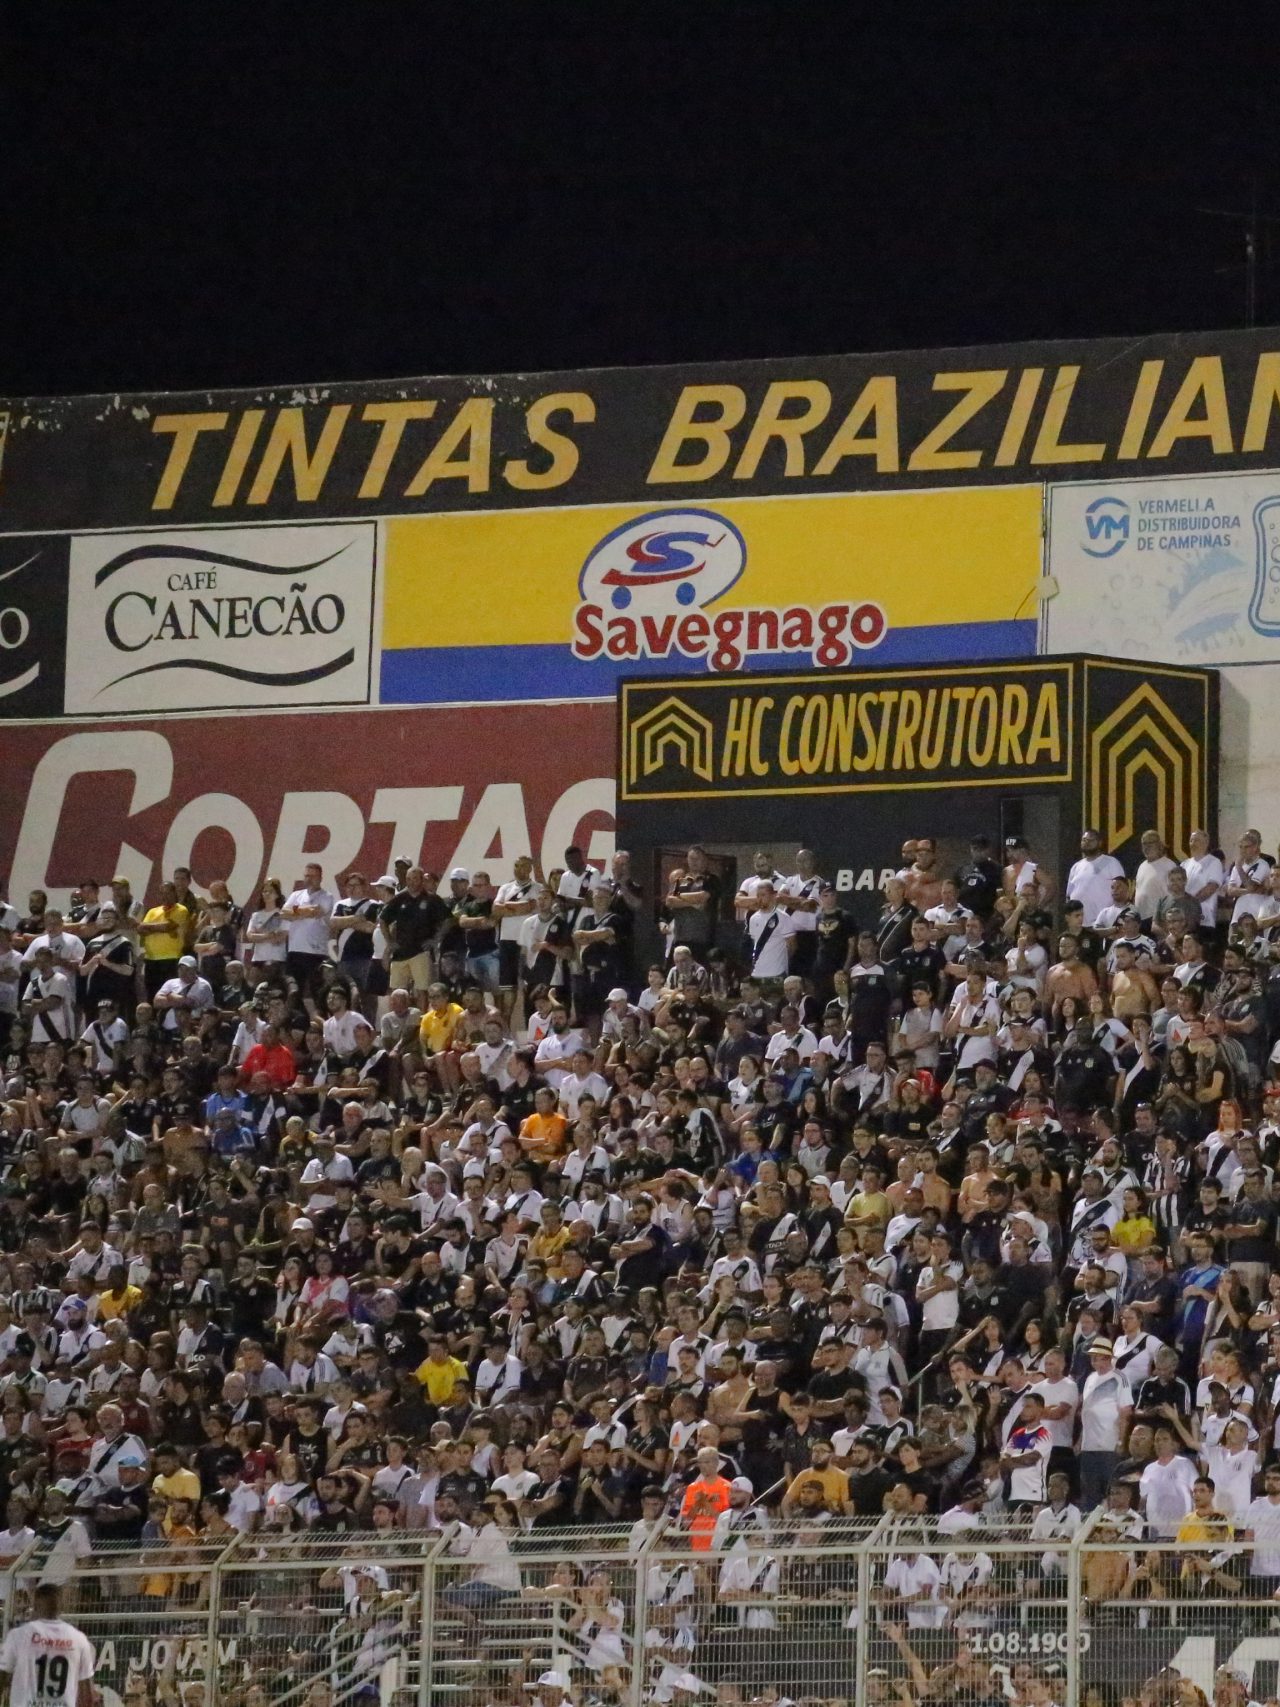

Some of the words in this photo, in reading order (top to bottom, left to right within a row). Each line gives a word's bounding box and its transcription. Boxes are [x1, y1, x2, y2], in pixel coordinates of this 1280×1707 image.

[152, 393, 596, 510] TINTAS
[1137, 515, 1241, 533] DISTRIBUIDORA
[1137, 536, 1154, 551] DE
[1158, 533, 1231, 551] CAMPINAS
[167, 566, 218, 592] CAFÉ
[104, 582, 346, 653] CANECÃO
[575, 603, 885, 672] Savegnago
[721, 696, 775, 777] HC
[778, 682, 1061, 777] CONSTRUTORA
[966, 1631, 1091, 1654] 1.08.1900
[35, 1654, 69, 1698] 19
